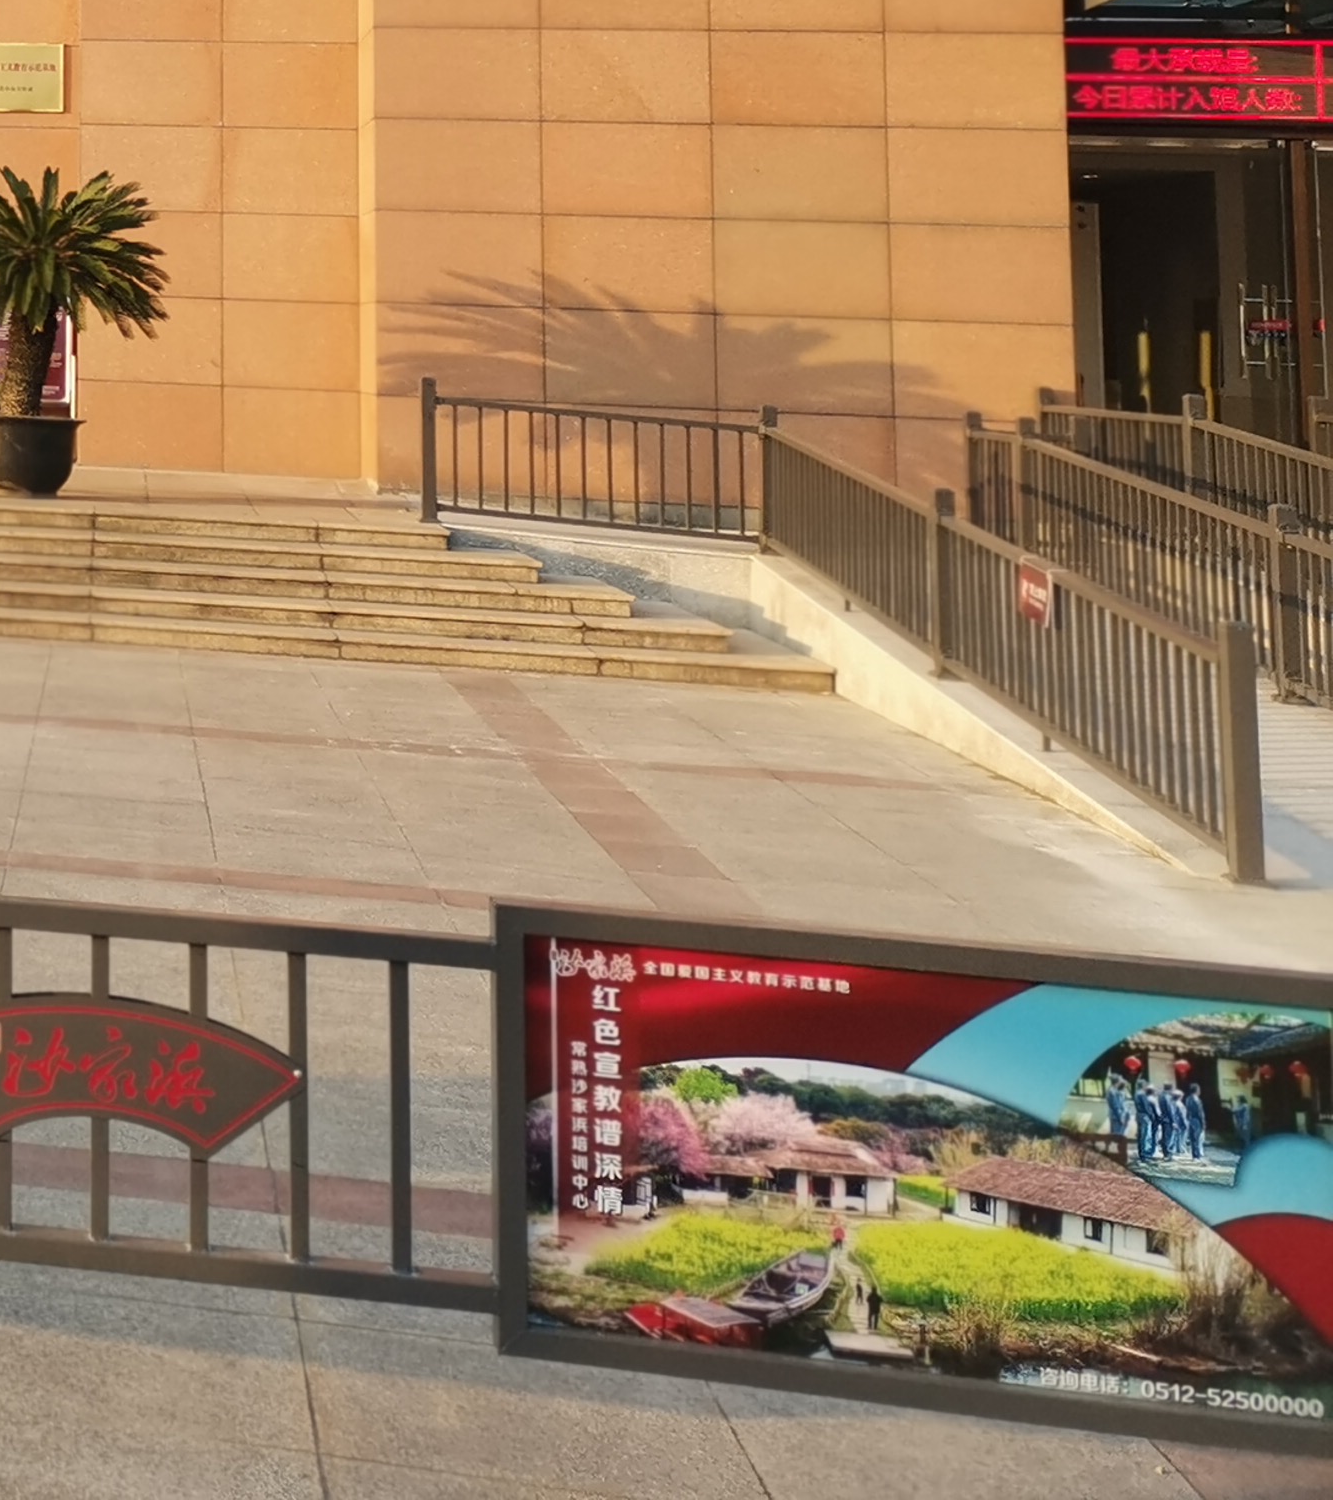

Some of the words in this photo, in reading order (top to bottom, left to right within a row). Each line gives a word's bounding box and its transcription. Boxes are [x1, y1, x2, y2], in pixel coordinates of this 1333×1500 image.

[642, 960, 851, 994] 全国爱国主义教育示范基地
[570, 1041, 589, 1210] 常熟沙家浜培训中心
[592, 985, 624, 1216] 红色宣教谱深情
[1140, 1379, 1325, 1418] 0512-52500000
